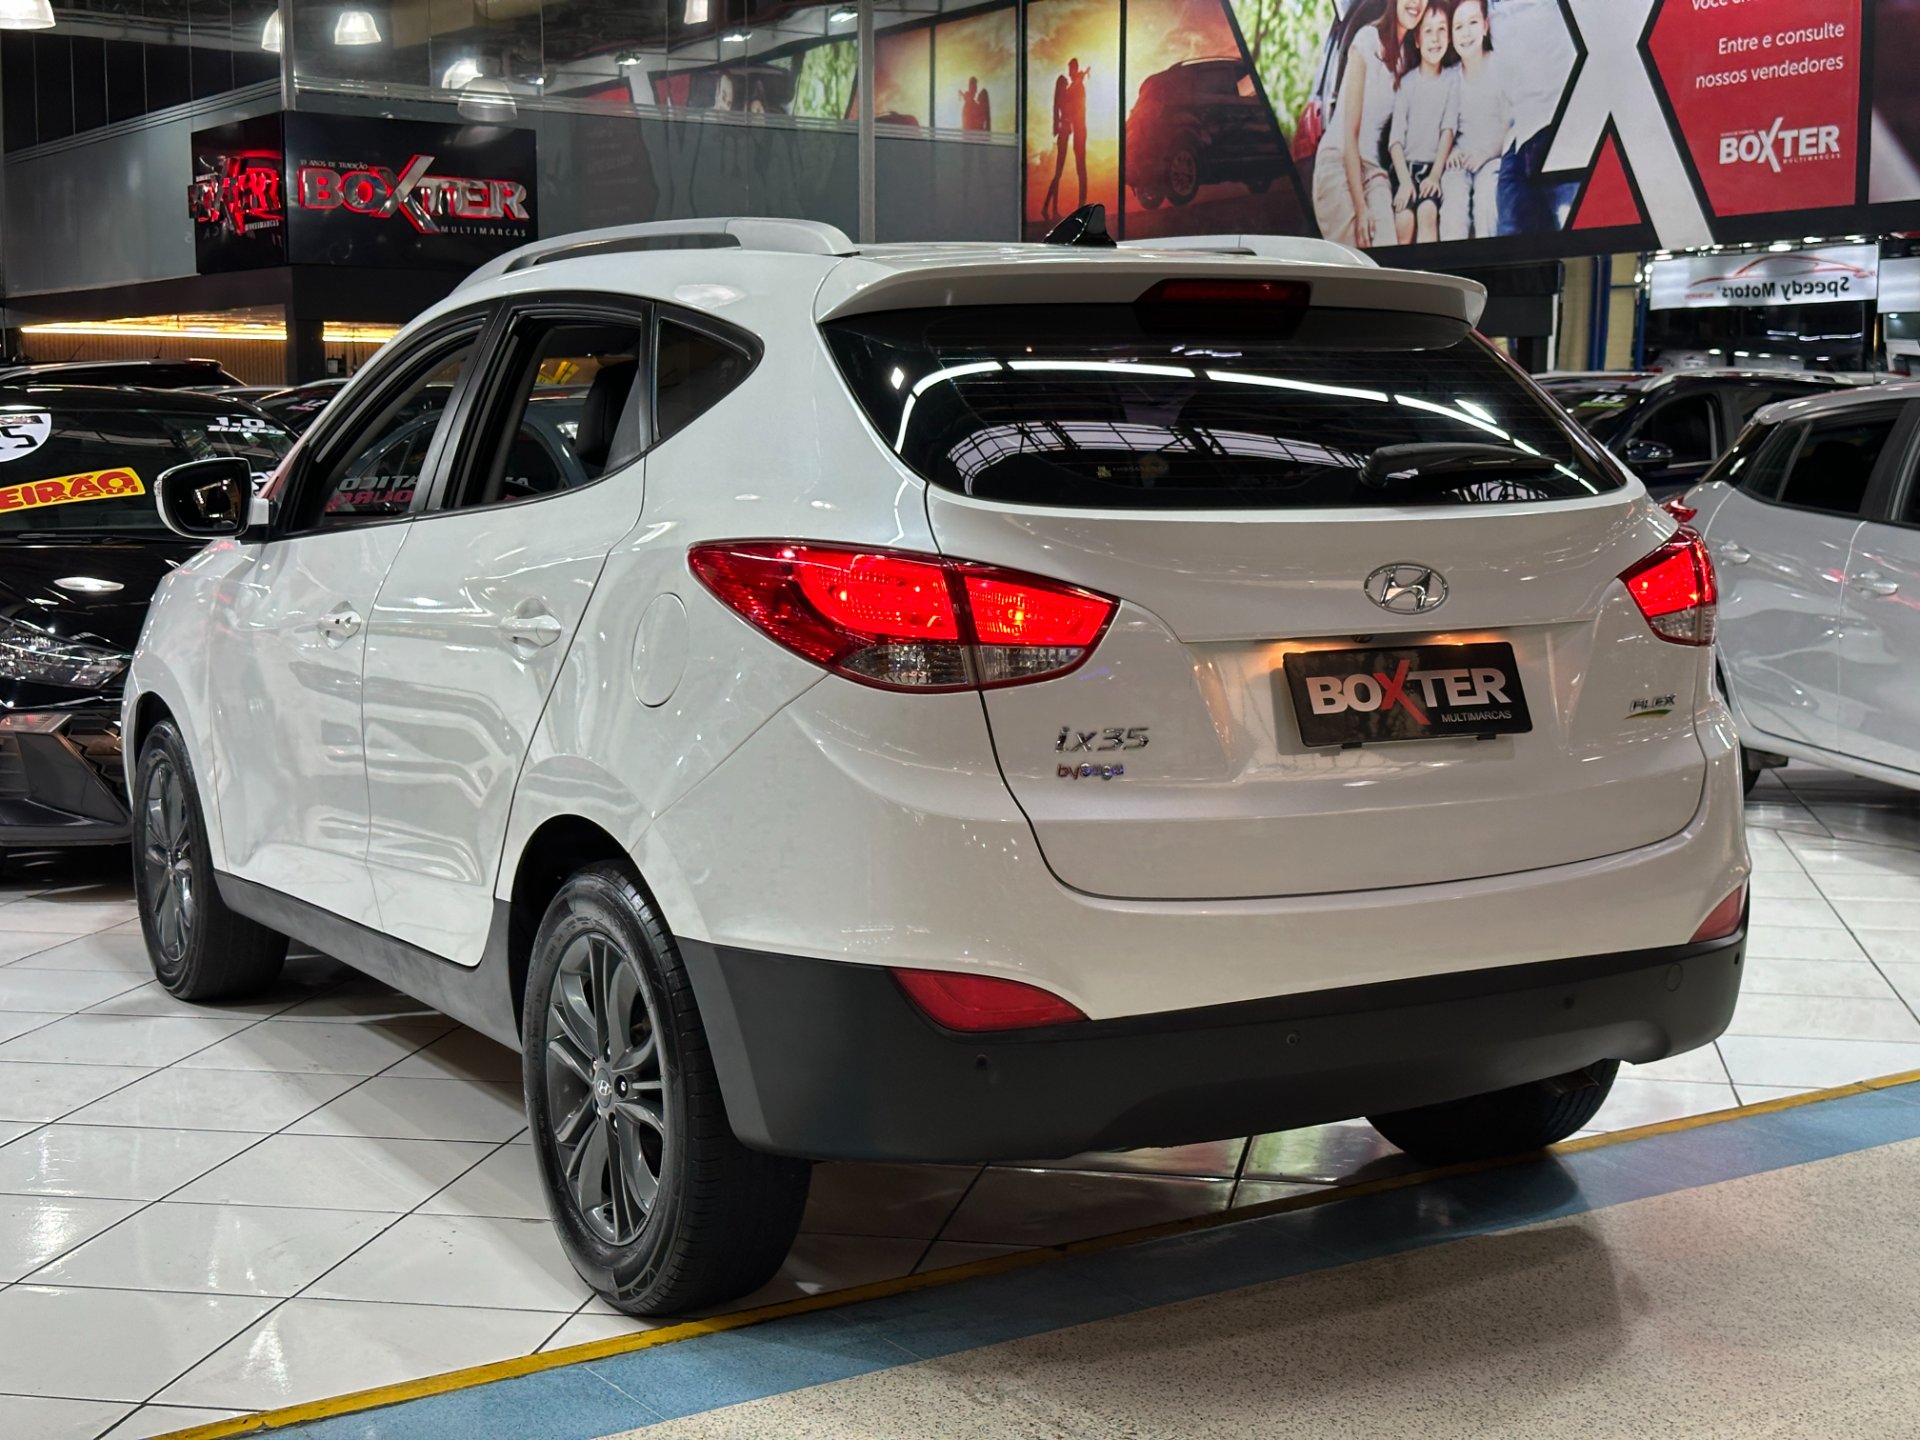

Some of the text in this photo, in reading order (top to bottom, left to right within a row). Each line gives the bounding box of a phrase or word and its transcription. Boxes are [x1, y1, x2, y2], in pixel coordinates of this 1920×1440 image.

[1718, 22, 1845, 55] Entre e consulte
[1695, 55, 1844, 89] nossos vendedores
[1719, 116, 1840, 173] BOXTER
[297, 154, 530, 234] BOXTER
[441, 225, 527, 238] MULTIMARCAS
[1306, 659, 1512, 726] BOXTER
[1441, 710, 1512, 724] MULTIMARCAS
[1055, 726, 1150, 753] ix35
